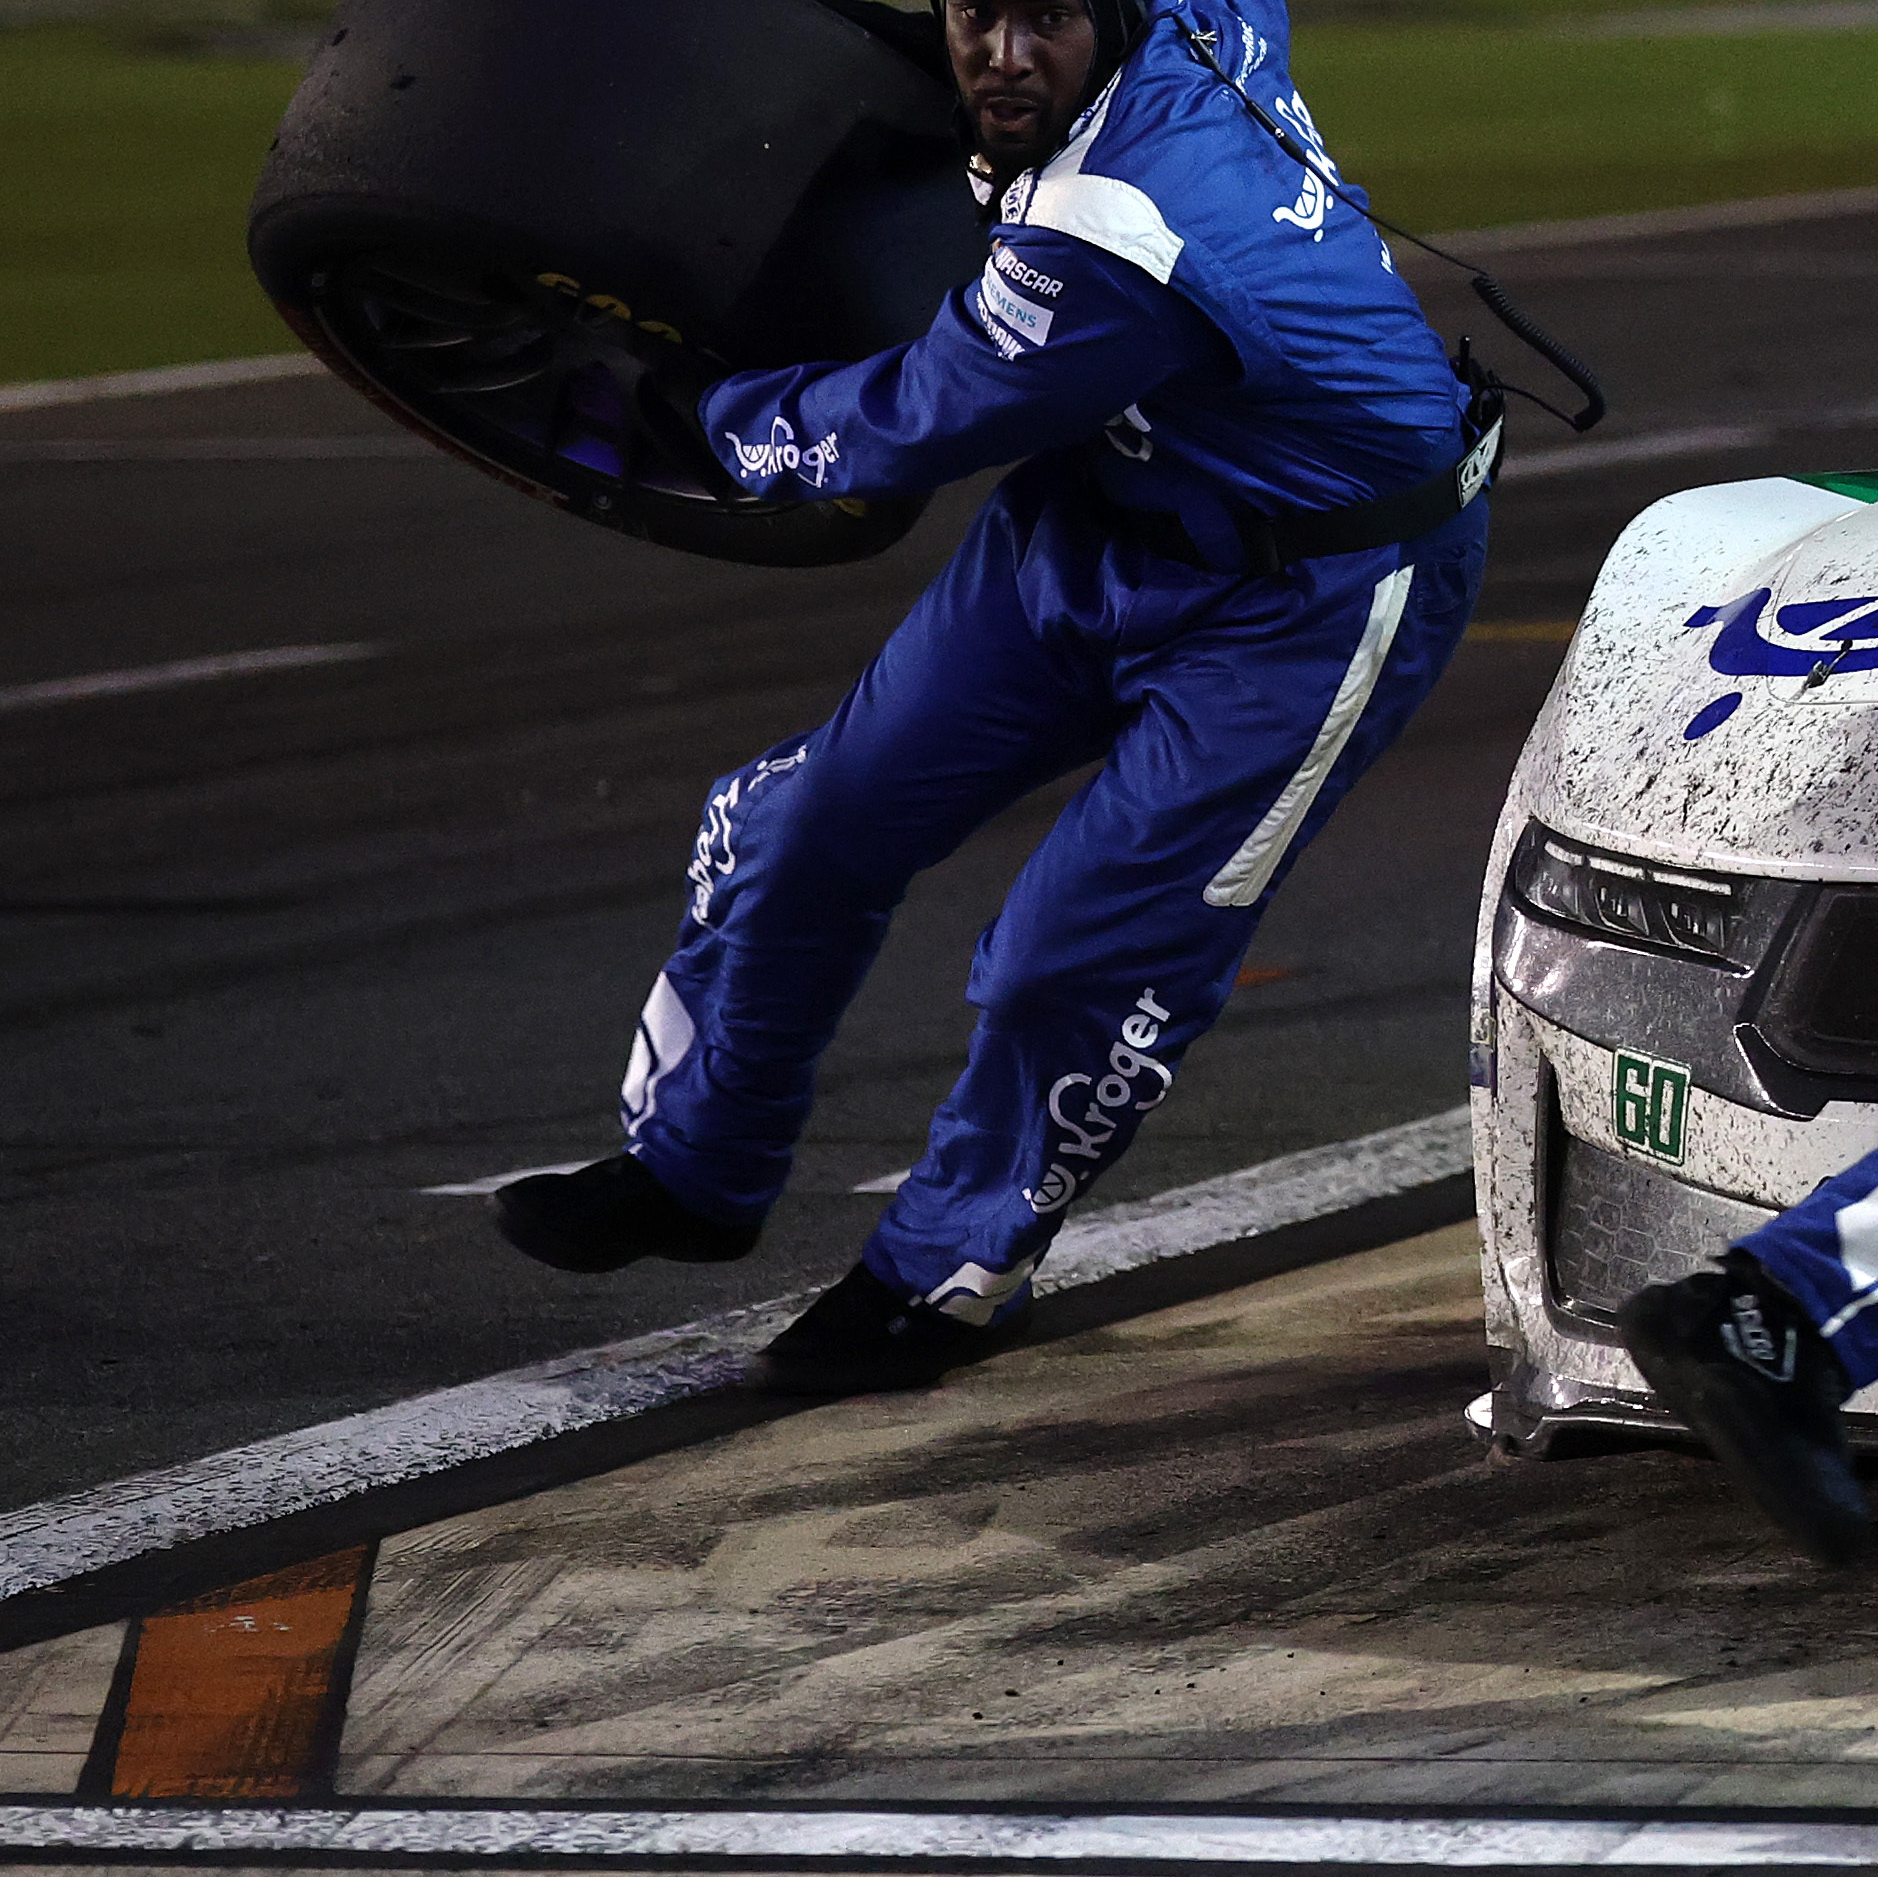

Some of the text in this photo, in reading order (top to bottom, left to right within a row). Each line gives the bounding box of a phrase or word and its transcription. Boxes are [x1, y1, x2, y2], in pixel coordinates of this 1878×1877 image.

[994, 245, 1064, 299] NASCAR
[767, 415, 839, 489] Kroger
[1048, 987, 1173, 1160] Kroger
[1616, 1052, 1688, 1159] 60
